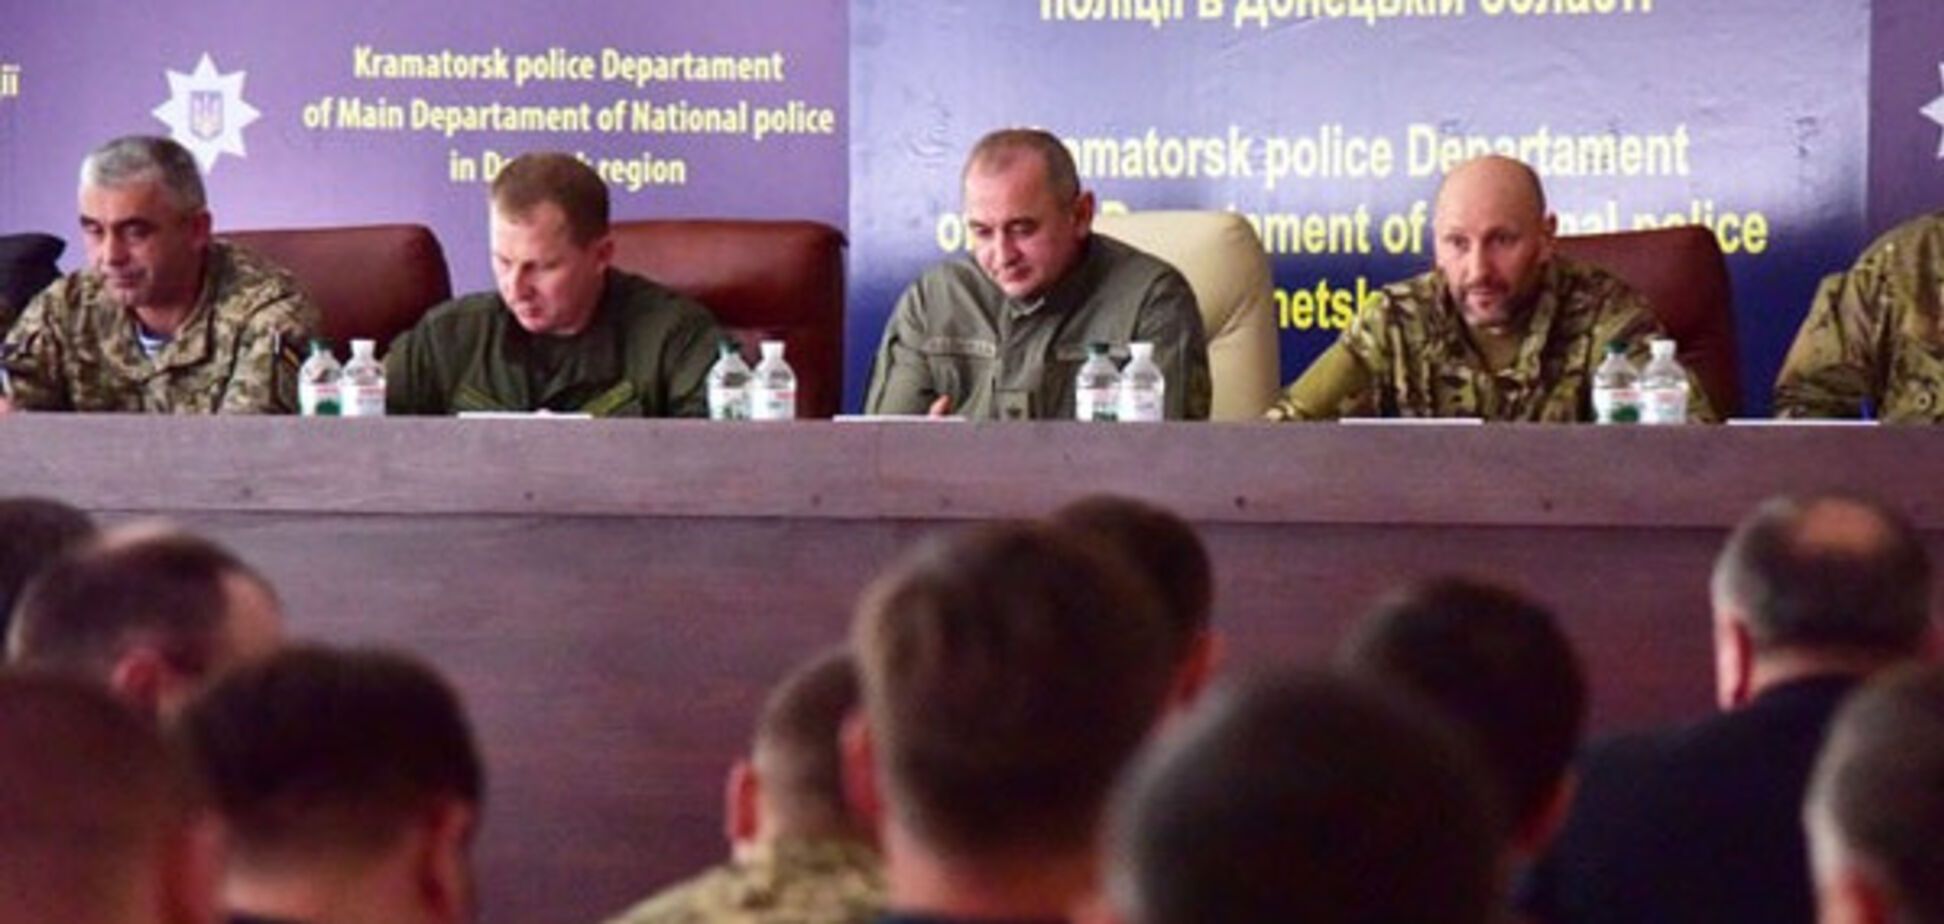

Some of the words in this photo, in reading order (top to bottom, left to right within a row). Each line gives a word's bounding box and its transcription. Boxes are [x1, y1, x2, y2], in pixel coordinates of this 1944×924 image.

[354, 46, 509, 79] Kramatorsk
[516, 48, 596, 87] police
[602, 48, 785, 88] Departament
[303, 97, 333, 129] of
[337, 97, 405, 130] Main
[411, 99, 591, 138] Departament
[597, 100, 627, 132] of
[631, 100, 748, 133] National
[753, 101, 835, 141] police
[450, 149, 476, 182] in
[600, 152, 687, 192] region
[1064, 125, 1253, 178] matorsk
[1265, 124, 1395, 191] police
[1382, 201, 1427, 254] of
